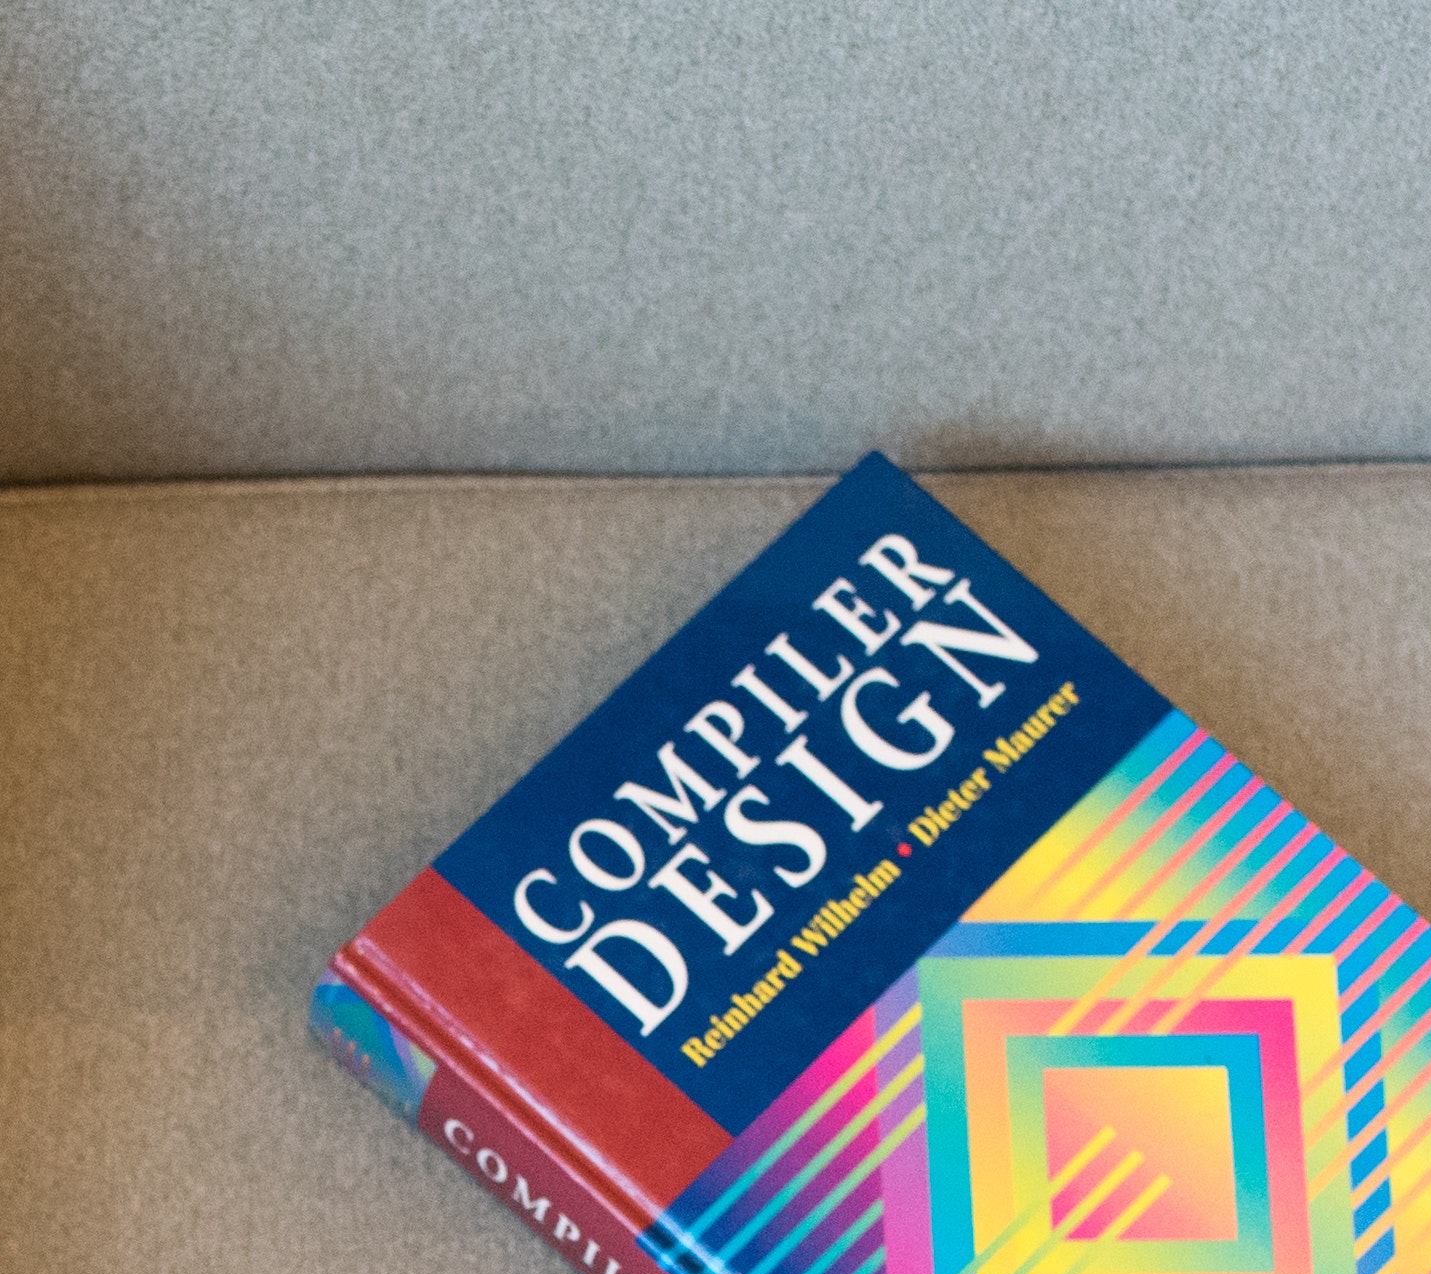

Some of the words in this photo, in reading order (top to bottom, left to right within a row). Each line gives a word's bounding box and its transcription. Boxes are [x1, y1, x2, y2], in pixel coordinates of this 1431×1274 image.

[513, 534, 956, 945] COMPILER
[565, 578, 1039, 1037] DESIGN
[680, 949, 803, 1068] Reinhard
[791, 858, 902, 957] Wilhelm
[907, 767, 991, 847] Dieter
[983, 682, 1080, 773] Maurer
